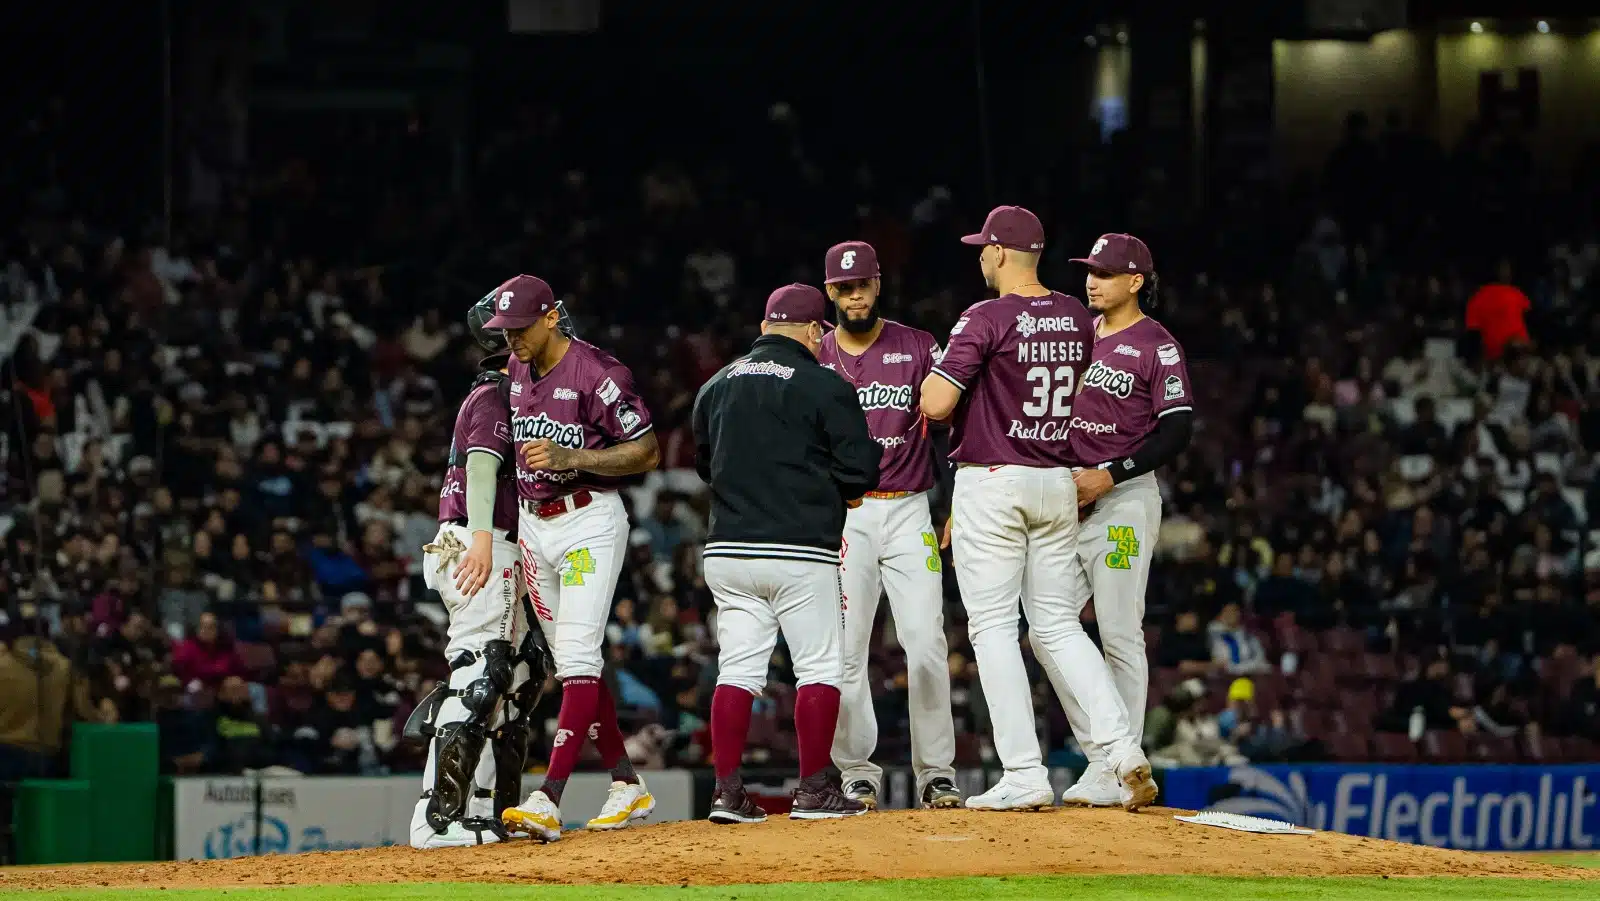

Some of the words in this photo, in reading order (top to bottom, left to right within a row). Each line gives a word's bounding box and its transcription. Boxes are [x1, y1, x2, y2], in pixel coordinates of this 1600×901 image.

[1037, 317, 1079, 332] ARIEL
[1018, 341, 1083, 363] MENESES
[1022, 365, 1074, 417] 32
[1084, 360, 1134, 399] teros
[1006, 419, 1040, 441] Red
[500, 579, 512, 640] caliente.mx
[1334, 773, 1596, 850] Electrolit
